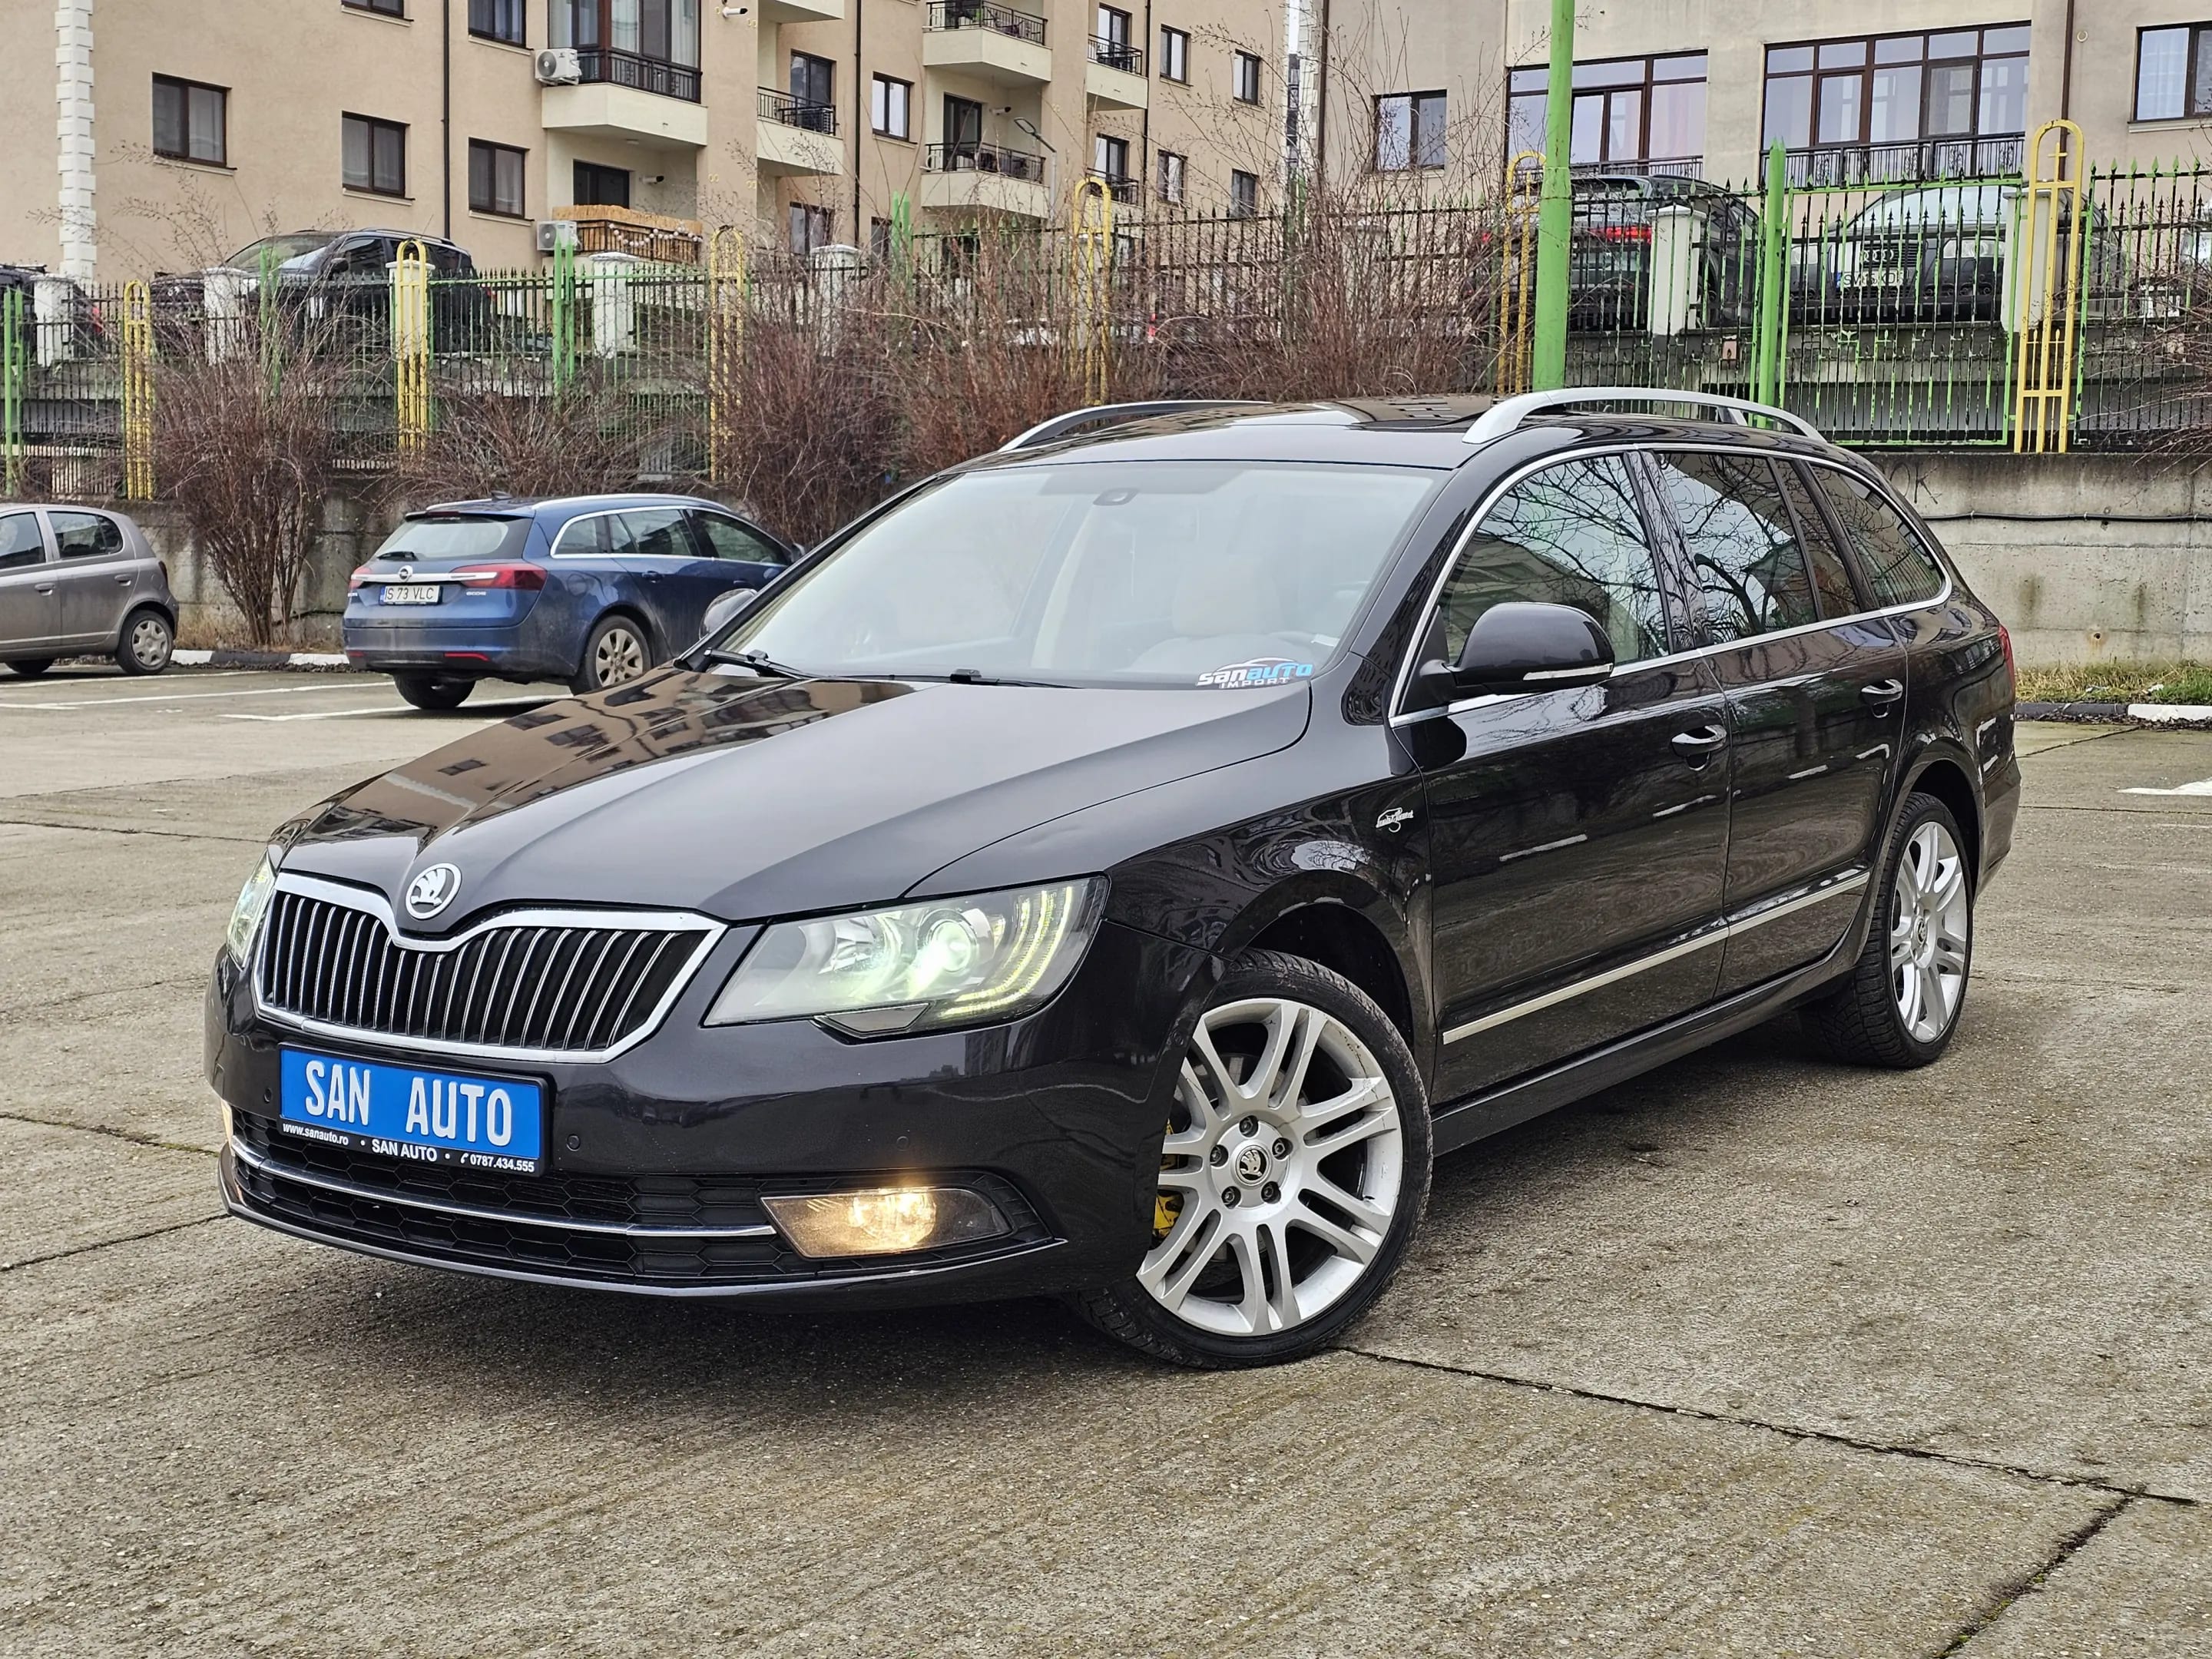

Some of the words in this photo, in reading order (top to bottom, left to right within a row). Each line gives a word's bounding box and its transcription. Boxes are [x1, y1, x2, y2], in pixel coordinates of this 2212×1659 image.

[385, 587, 394, 600] IS
[396, 587, 409, 599] 73
[413, 587, 434, 599] VLC
[1219, 676, 1290, 689] IMPORT
[306, 1060, 371, 1125] SAN
[406, 1077, 512, 1147] AUTO
[283, 1123, 349, 1146] www.sanauto.ro
[372, 1139, 399, 1157] SAN
[400, 1144, 437, 1162] AUTO
[469, 1154, 535, 1173] 0787.434.555
